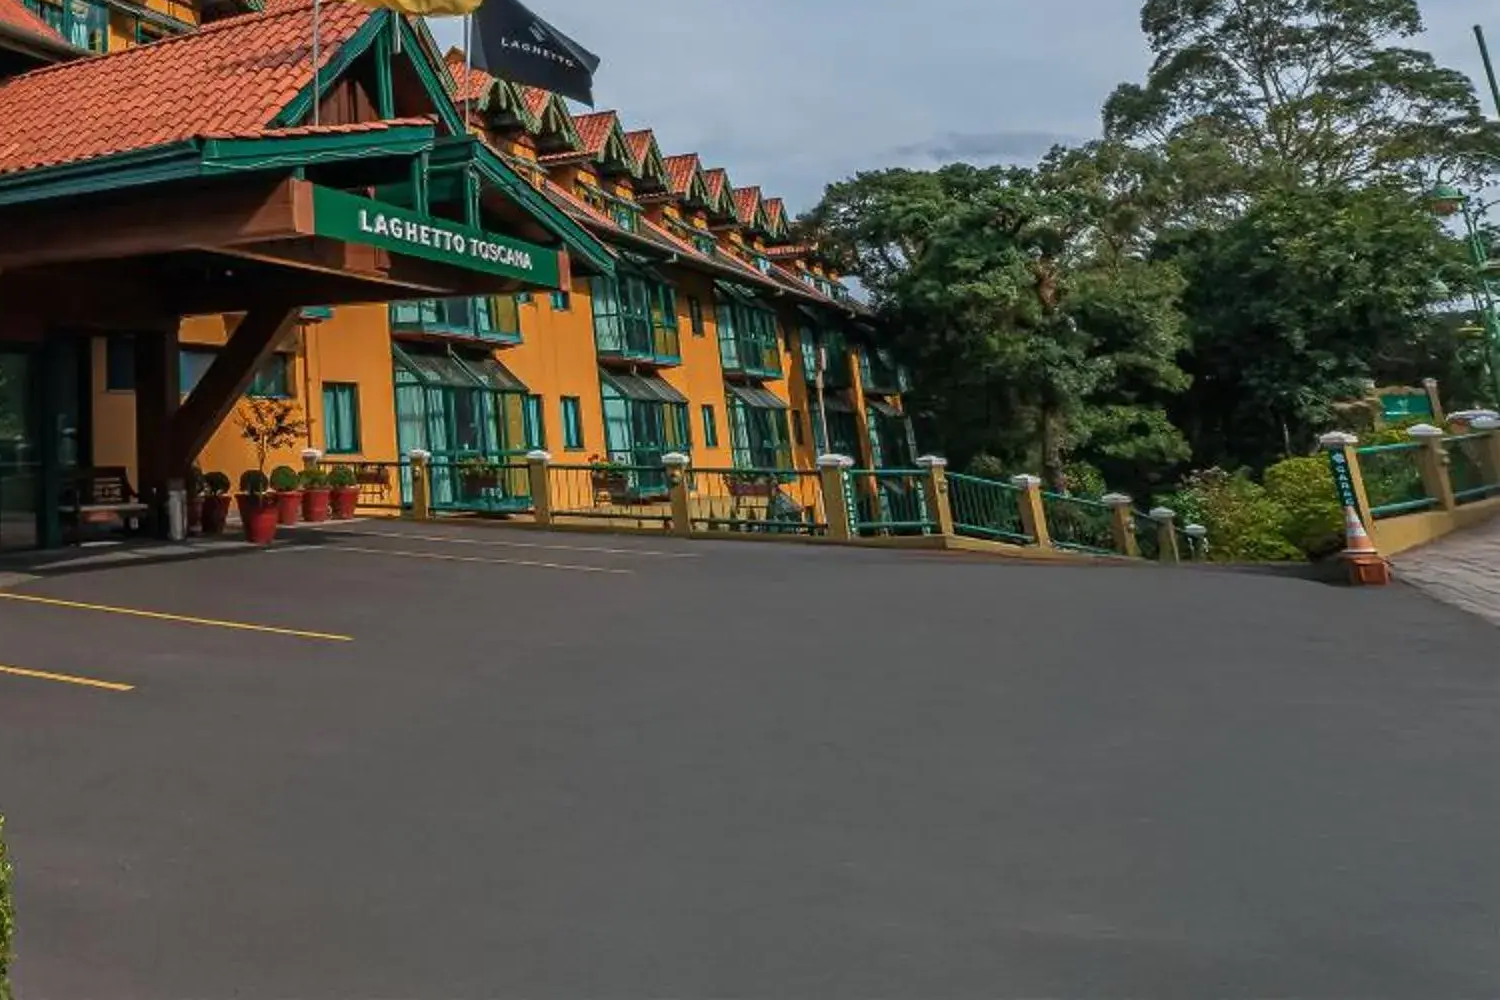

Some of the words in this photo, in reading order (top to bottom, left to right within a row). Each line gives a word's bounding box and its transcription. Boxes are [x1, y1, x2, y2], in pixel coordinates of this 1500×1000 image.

[500, 36, 576, 69] LAGHETTO
[357, 209, 467, 255] LAGHETTO
[468, 237, 534, 271] TOSCANA
